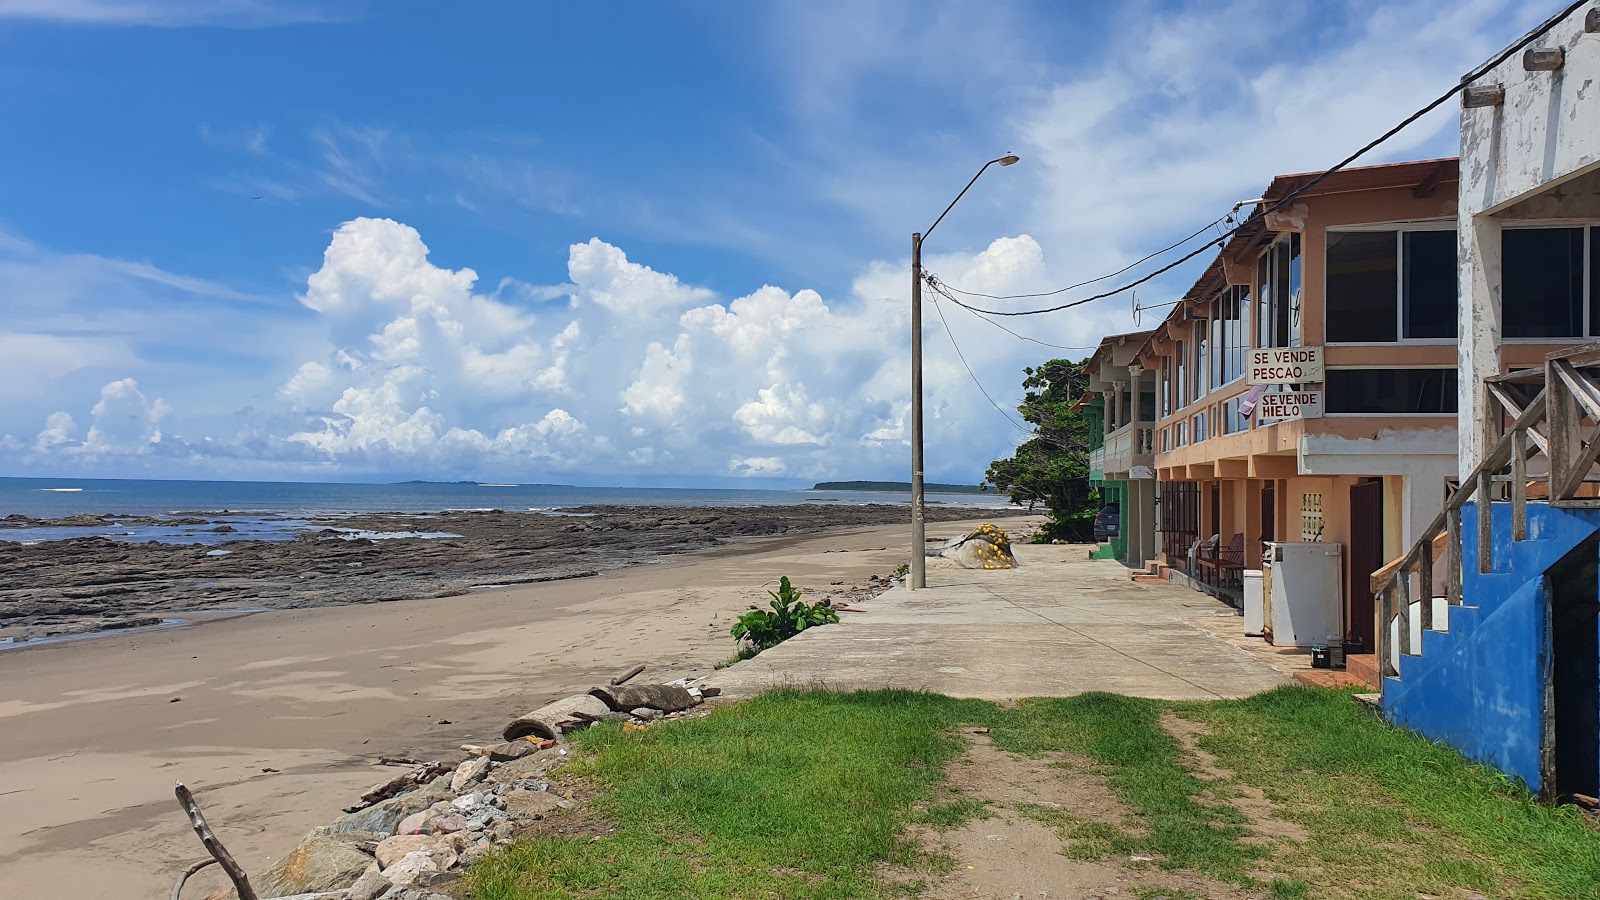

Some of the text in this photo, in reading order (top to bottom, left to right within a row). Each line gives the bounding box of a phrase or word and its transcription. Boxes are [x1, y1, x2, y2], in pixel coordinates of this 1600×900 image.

[1254, 350, 1316, 364] SE VENDE
[1253, 366, 1302, 380] PESCAO
[1262, 405, 1300, 417] HIELO
